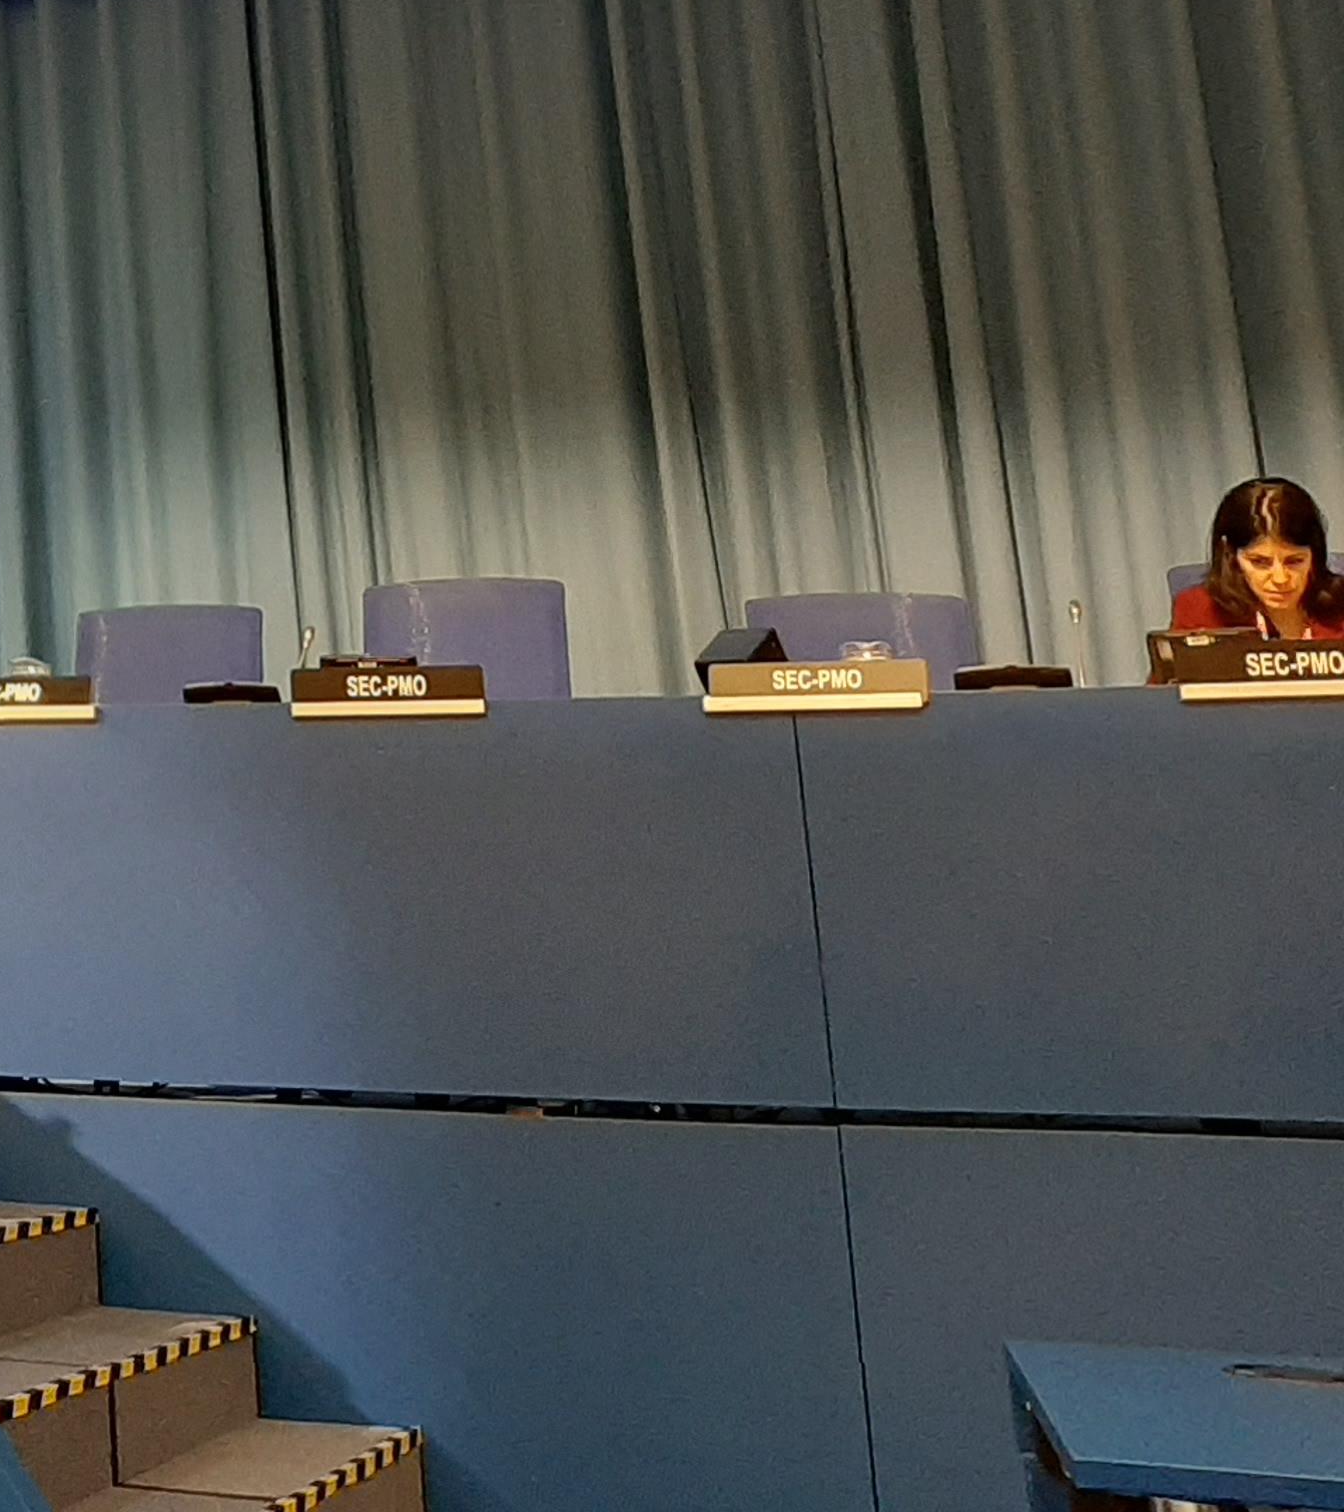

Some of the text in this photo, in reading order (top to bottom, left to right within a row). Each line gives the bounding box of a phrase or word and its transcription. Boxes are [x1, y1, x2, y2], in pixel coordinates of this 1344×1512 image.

[1244, 649, 1344, 677] SEC-PMO
[345, 673, 428, 697] SEC-PMO
[772, 668, 863, 690] SEC-PMO
